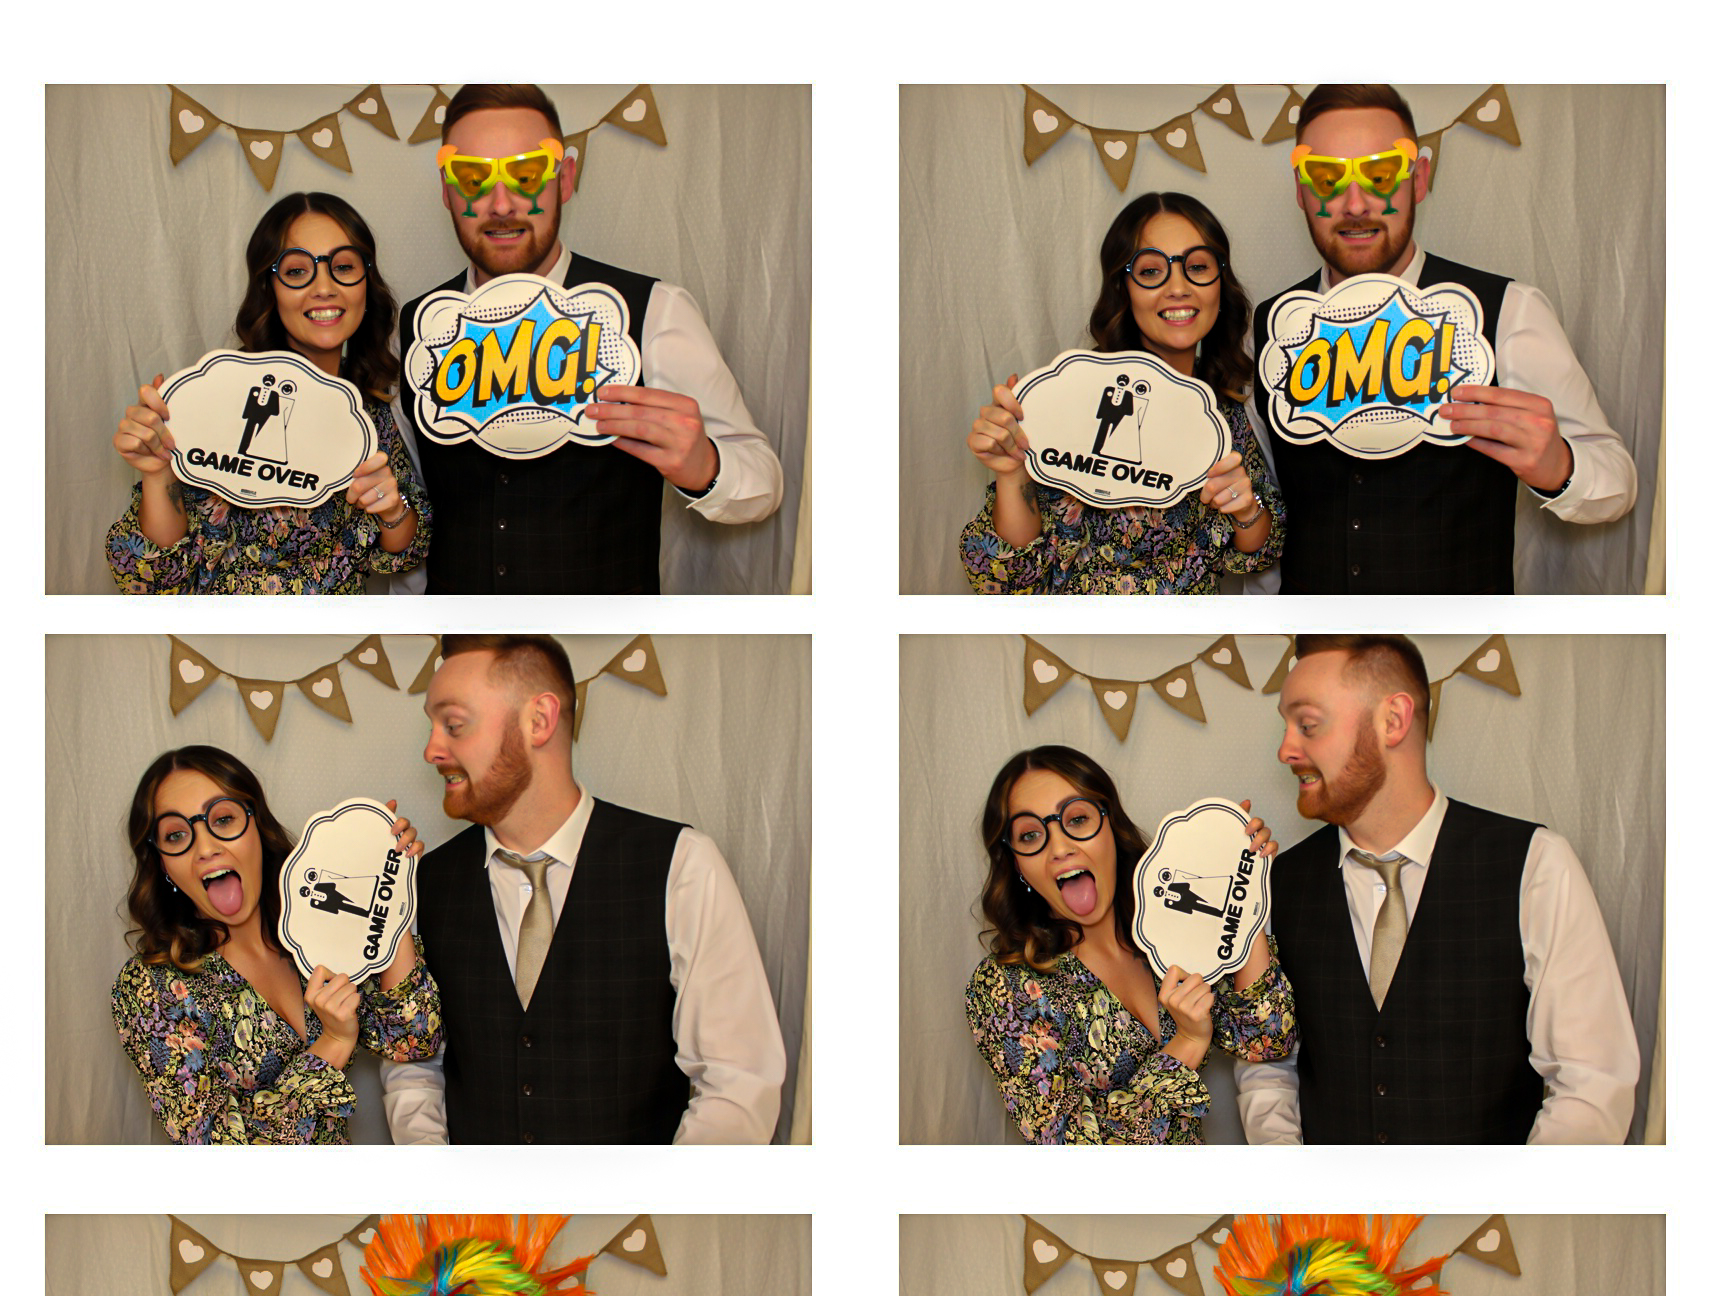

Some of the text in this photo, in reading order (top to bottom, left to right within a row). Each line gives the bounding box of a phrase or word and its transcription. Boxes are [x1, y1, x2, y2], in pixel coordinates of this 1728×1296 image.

[430, 318, 604, 408] OMG!
[1284, 318, 1458, 408] OMG!
[187, 447, 320, 491] GAME OVER
[1041, 447, 1174, 491] GAME OVER
[363, 848, 403, 961] GAME OVER
[1217, 848, 1257, 961] GAME OVER
